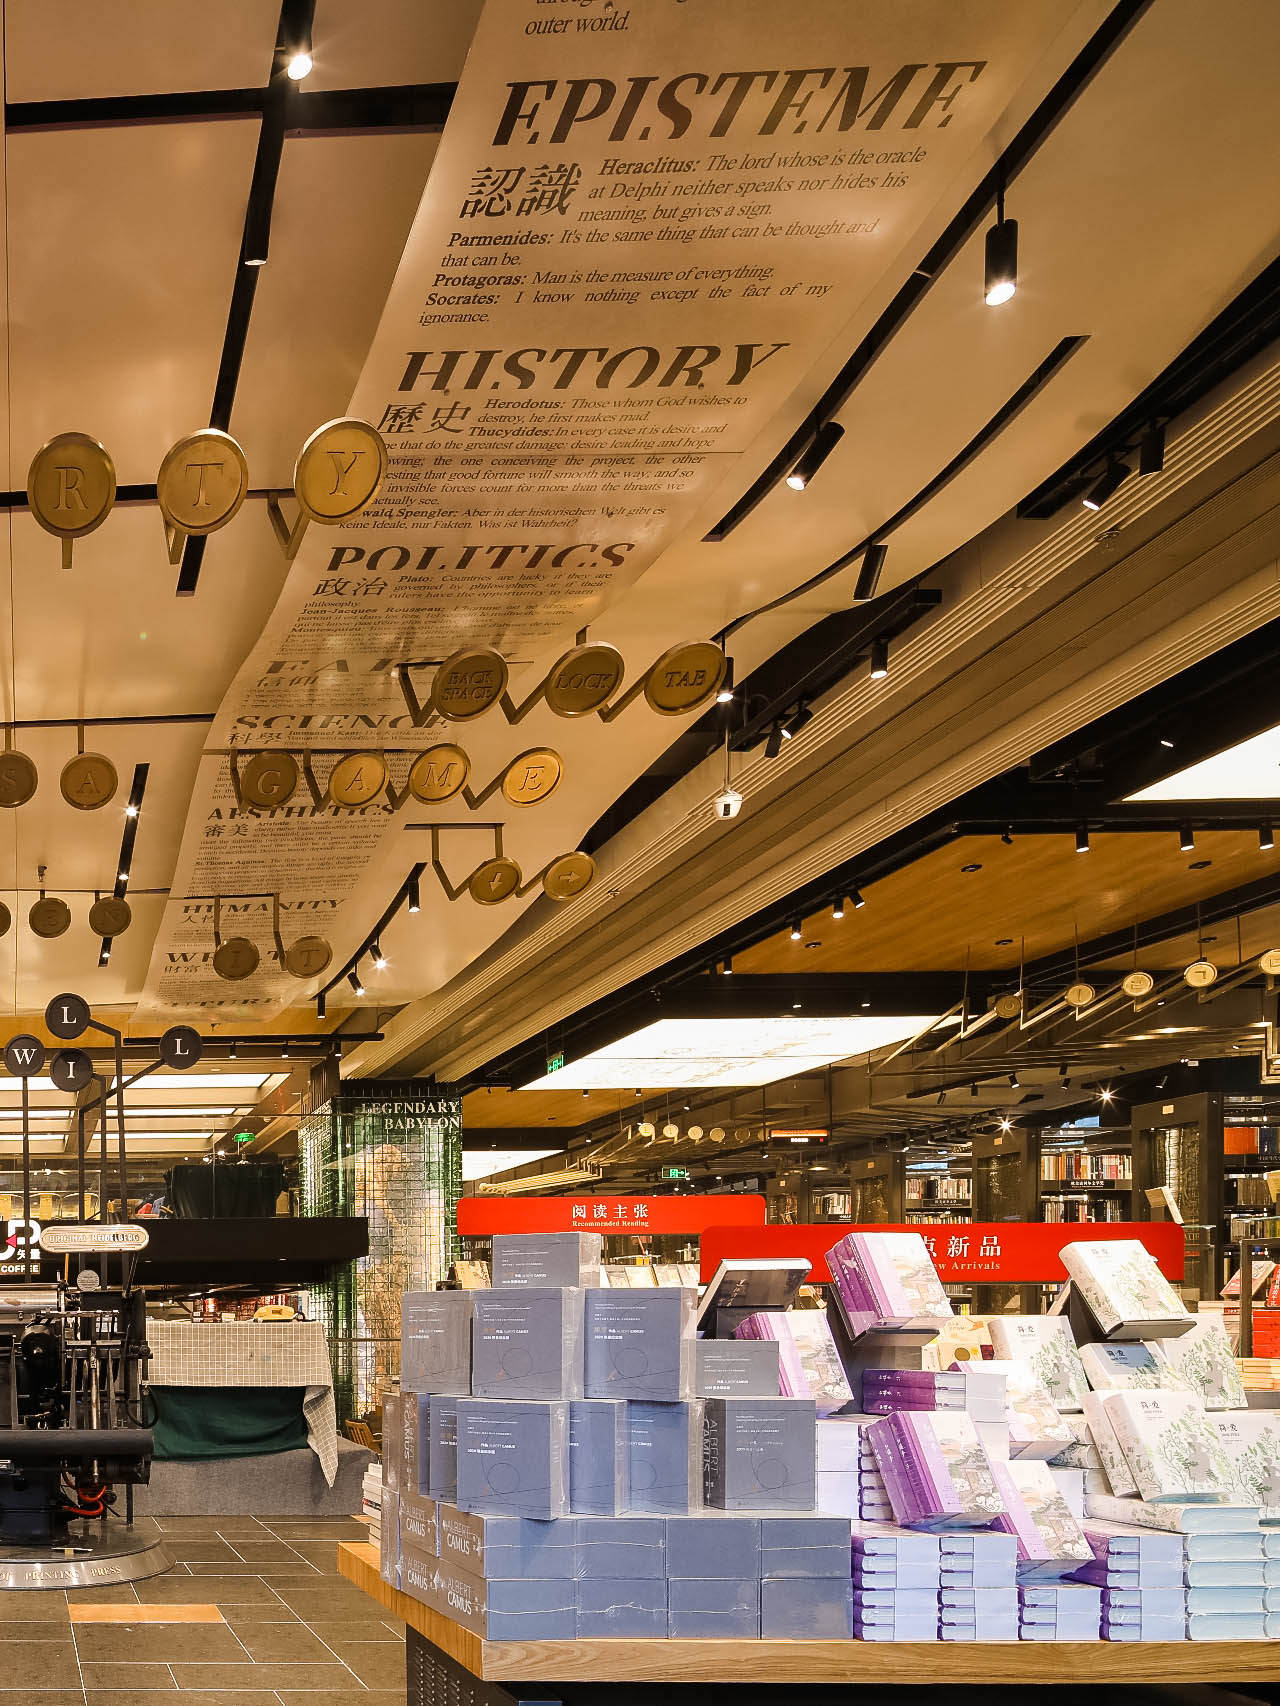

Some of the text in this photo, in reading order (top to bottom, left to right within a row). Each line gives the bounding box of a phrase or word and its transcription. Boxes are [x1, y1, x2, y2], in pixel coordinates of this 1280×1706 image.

[524, 10, 629, 35] outer world.
[491, 60, 987, 146] EPISTEME
[598, 147, 926, 176] Heraclitus: The lord whose is the oracle
[459, 162, 582, 219] 認識
[588, 171, 910, 201] at Delphi neither speaks nor hides his
[577, 201, 772, 224] meaning, but gives a sign.
[447, 218, 880, 248] Parmenides: It's the same thing that can be thought and
[440, 253, 521, 267] that can be.
[431, 264, 775, 290] Protagoras: Man is the measure of everything.
[425, 283, 832, 307] Socrates: I know nothing except the fact of my
[419, 310, 490, 326] ignorance.
[397, 343, 791, 392] HISTORY
[326, 543, 636, 571] POLITICS
[312, 576, 388, 597] 政治
[447, 671, 495, 685] BACK
[554, 672, 611, 691] LOCK
[665, 670, 706, 688] TAB
[441, 687, 494, 700] SPACE
[361, 1101, 459, 1116] LEGENDARY
[383, 1116, 459, 1129] BABYLON
[572, 1204, 649, 1219] 阅读主张
[1, 1265, 39, 1273] COFFE
[951, 1261, 1001, 1270] Arrivals
[406, 1518, 425, 1537] CAMUS
[447, 1533, 470, 1555] CAMUS
[91, 1566, 121, 1577] PRESS
[407, 1570, 428, 1590] CAMUS
[447, 1591, 472, 1615] CAMUS
